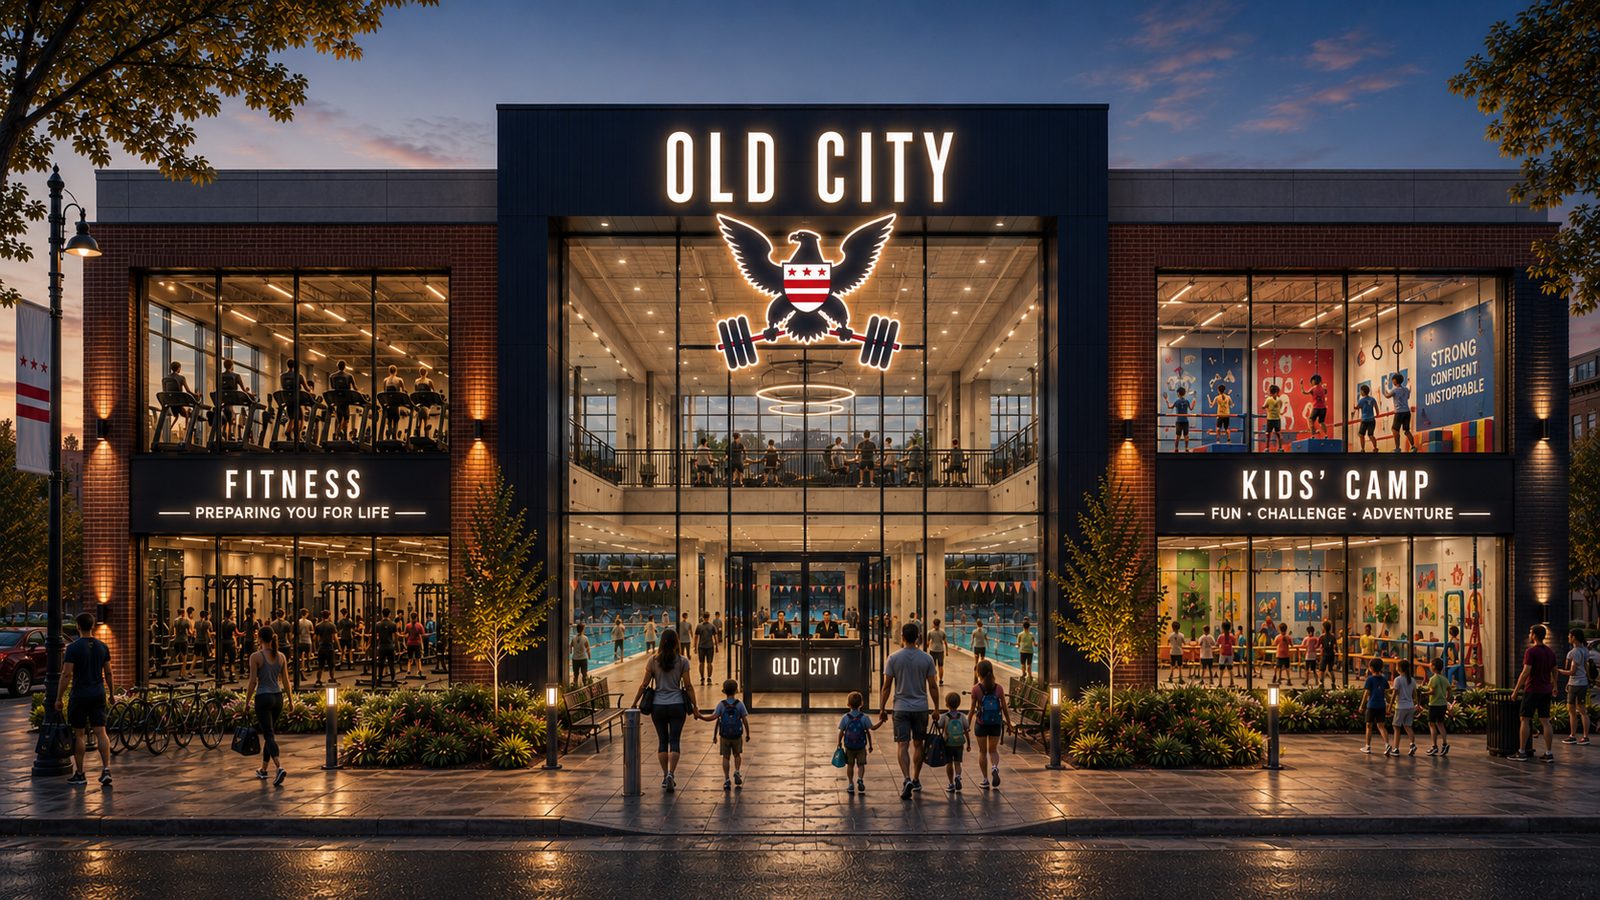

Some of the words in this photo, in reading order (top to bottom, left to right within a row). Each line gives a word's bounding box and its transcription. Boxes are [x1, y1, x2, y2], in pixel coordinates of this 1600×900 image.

[666, 131, 775, 204] OLD
[817, 131, 955, 204] CITY
[1431, 339, 1477, 368] STRONG
[1431, 361, 1478, 387] CONFIDENT
[1425, 377, 1485, 406] UNSTOPPABLE
[225, 469, 361, 499] FITNESS
[1346, 469, 1430, 500] CAMP
[195, 506, 281, 519] PREPARING
[287, 506, 317, 519] YOU
[323, 506, 353, 519] FOR
[358, 506, 390, 519] LIFE
[1211, 507, 1241, 520] FUN
[1257, 507, 1347, 520] CHALLENGE
[1362, 507, 1454, 520] ADVENTURE
[772, 657, 800, 676] OLD
[808, 657, 841, 676] CITY
